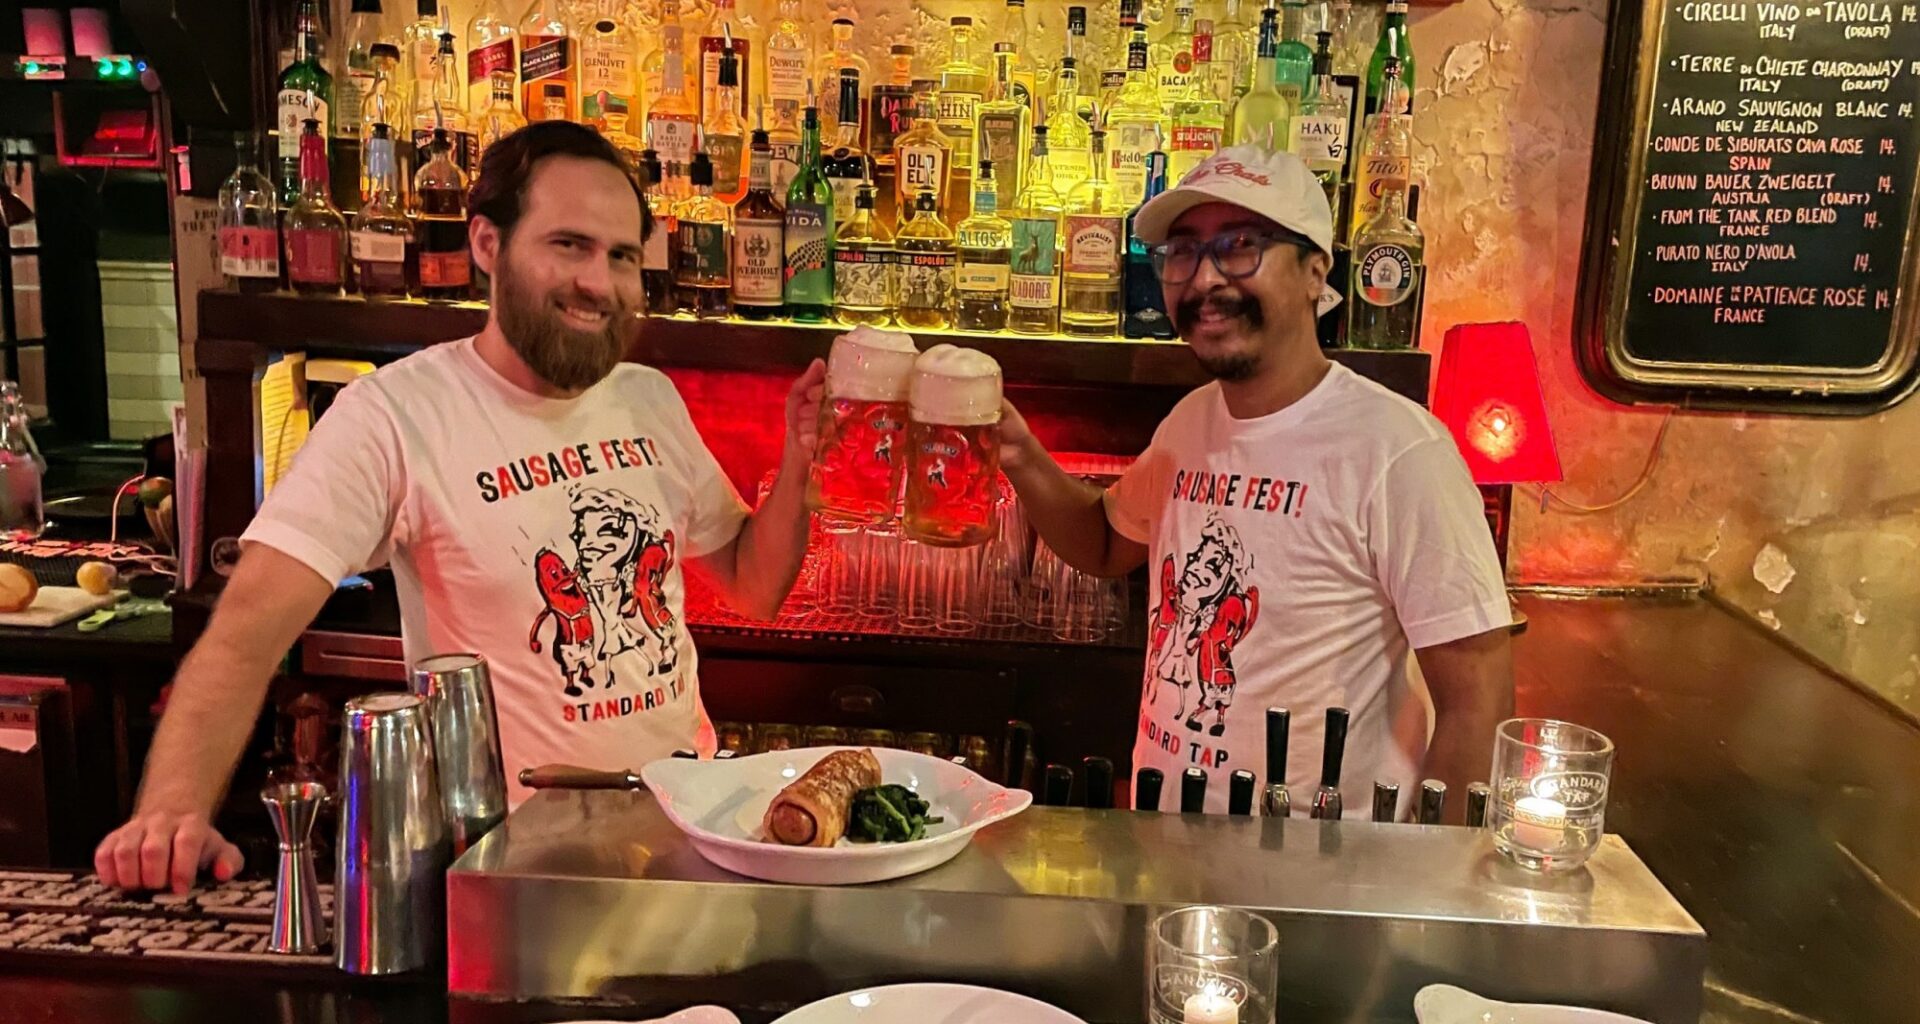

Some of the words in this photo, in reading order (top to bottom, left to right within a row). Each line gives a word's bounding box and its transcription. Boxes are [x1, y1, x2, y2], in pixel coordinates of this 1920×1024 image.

[1682, 2, 1746, 22] CIRELLI
[1757, 2, 1800, 21] VINO
[1823, 1, 1892, 22] TAVOLA
[1760, 24, 1795, 40] ITALY
[1845, 23, 1891, 39] (DRAFT)
[542, 51, 561, 62] LABEL
[584, 57, 625, 69] GLENLIVET
[598, 67, 609, 78] 12
[1679, 55, 1735, 73] TERRE
[1756, 56, 1808, 77] CHIETE
[1812, 58, 1903, 78] CHARDONNAY
[1739, 79, 1781, 93] ITALY
[1841, 78, 1889, 92] (DRAFT)
[1670, 98, 1726, 116] ARANO
[1738, 100, 1823, 118] SAUVIGNON
[1836, 102, 1889, 118] BLANC
[1301, 123, 1342, 136] HAKU
[1715, 120, 1743, 133] NEW
[1753, 120, 1818, 134] ZEALAND
[1327, 137, 1343, 158] 白
[1654, 136, 1700, 153] CONDE
[1705, 136, 1723, 153] DE
[1727, 136, 1793, 153] SIBURATS
[1796, 138, 1826, 154] CAVA
[1831, 138, 1864, 155] ROSE
[1366, 160, 1406, 175] Tito's
[1729, 156, 1772, 171] SPAIN
[1651, 174, 1697, 190] BRUNN
[1705, 174, 1752, 190] BAUER
[1757, 173, 1836, 190] ZWEIGELT
[1712, 192, 1770, 205] AUSTRIA
[1820, 192, 1871, 206] (DRAFT)
[785, 216, 822, 227] VIDA
[1660, 208, 1693, 225] FROM
[1698, 208, 1721, 224] THE
[1727, 208, 1762, 225] TANK
[1765, 208, 1792, 224] RED
[1796, 208, 1837, 225] BLEND
[1076, 232, 1113, 244] REVIVALIST
[1719, 225, 1770, 237] FRANCE
[959, 231, 997, 247] ALTOS
[1656, 245, 1700, 261] PURATO
[1705, 245, 1740, 261] NERO
[1745, 244, 1796, 260] D'AVOLA
[748, 259, 766, 267] OLD
[1363, 246, 1404, 277] PLYMOUTH
[1401, 259, 1411, 278] GIN
[1711, 261, 1749, 272] ITALY
[735, 267, 779, 276] OVERHOLT
[1654, 286, 1724, 305] DOMAINE
[1743, 286, 1816, 306] PATIENCE
[1714, 308, 1765, 323] FRANCE
[476, 444, 598, 503] SAUSAGE
[599, 437, 663, 471] FEST!
[1173, 469, 1241, 507] SAUSAGE
[1242, 477, 1309, 518] FEST!
[563, 686, 666, 723] STANDARD
[1189, 741, 1230, 769] TAP
